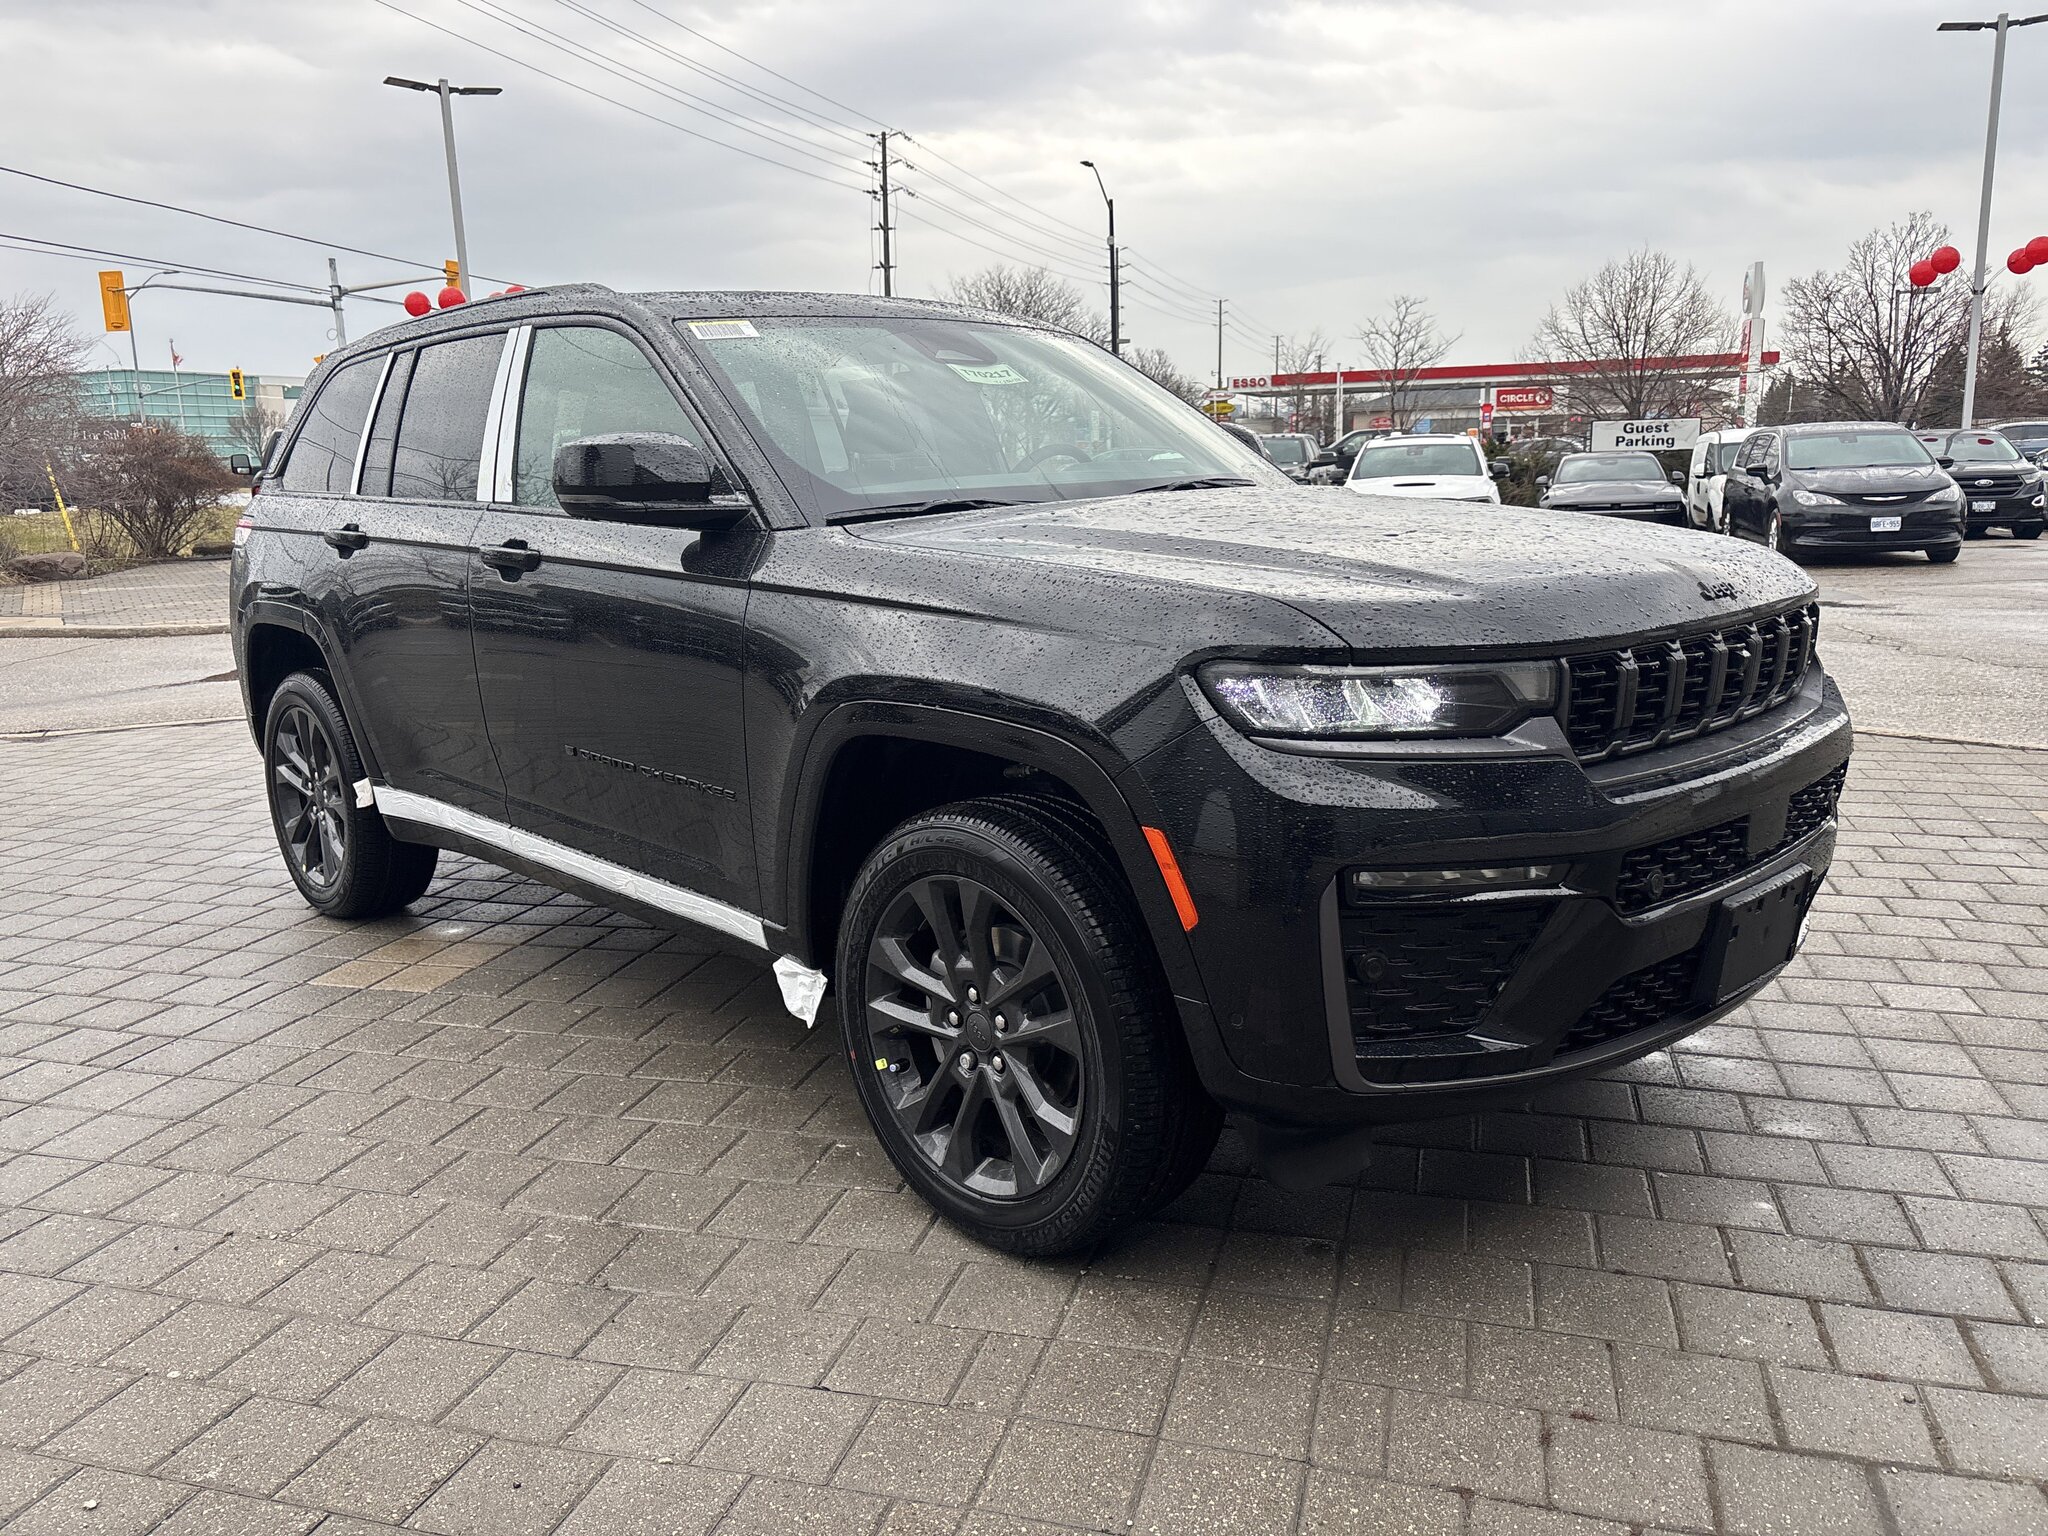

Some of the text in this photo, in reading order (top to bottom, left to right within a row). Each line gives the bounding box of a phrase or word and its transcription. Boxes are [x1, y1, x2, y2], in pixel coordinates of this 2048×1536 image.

[105, 384, 122, 392] 650
[133, 384, 151, 392] 650
[1233, 377, 1266, 388] ESSO
[1500, 394, 1534, 403] CIRCLE
[1623, 422, 1669, 434] Guest
[1616, 435, 1675, 448] Parking
[1697, 581, 1738, 601] Jeep
[579, 748, 738, 802] GRAND CHEROKEE
